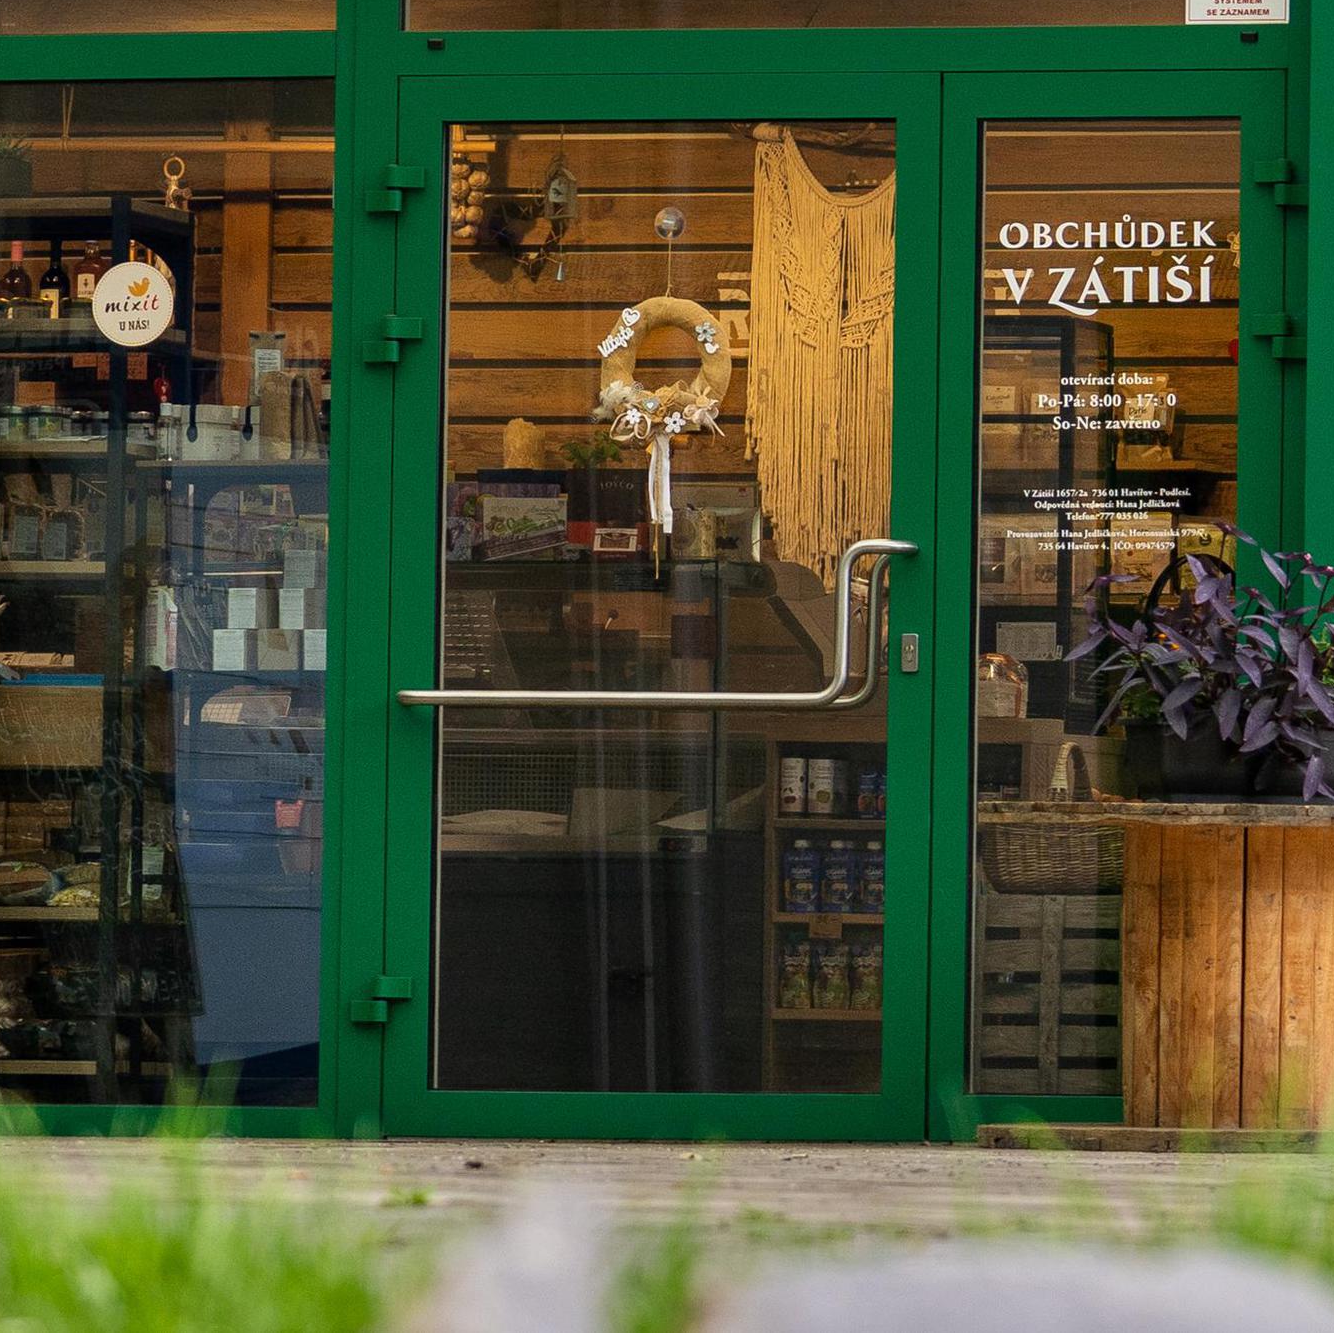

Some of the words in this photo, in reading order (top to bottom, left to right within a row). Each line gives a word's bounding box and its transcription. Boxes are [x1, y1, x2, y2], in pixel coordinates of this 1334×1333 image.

[999, 213, 1217, 249] OBCHŮDEK
[1001, 268, 1034, 305] V
[1047, 254, 1215, 317] ZÁTIŠÍ
[105, 294, 159, 313] mixit
[119, 321, 126, 331] U
[128, 318, 150, 331] NÁS!
[1061, 372, 1115, 386] otevírací
[1118, 372, 1153, 386] doba:
[1038, 393, 1086, 408] Po-Pá:
[1089, 393, 1122, 407] 8:00
[1052, 415, 1101, 430] So-Ne:
[1105, 417, 1161, 430] zavřeno
[1116, 499, 1137, 508] Hana
[1138, 499, 1181, 509] Jedličková
[1061, 529, 1083, 538] Hana
